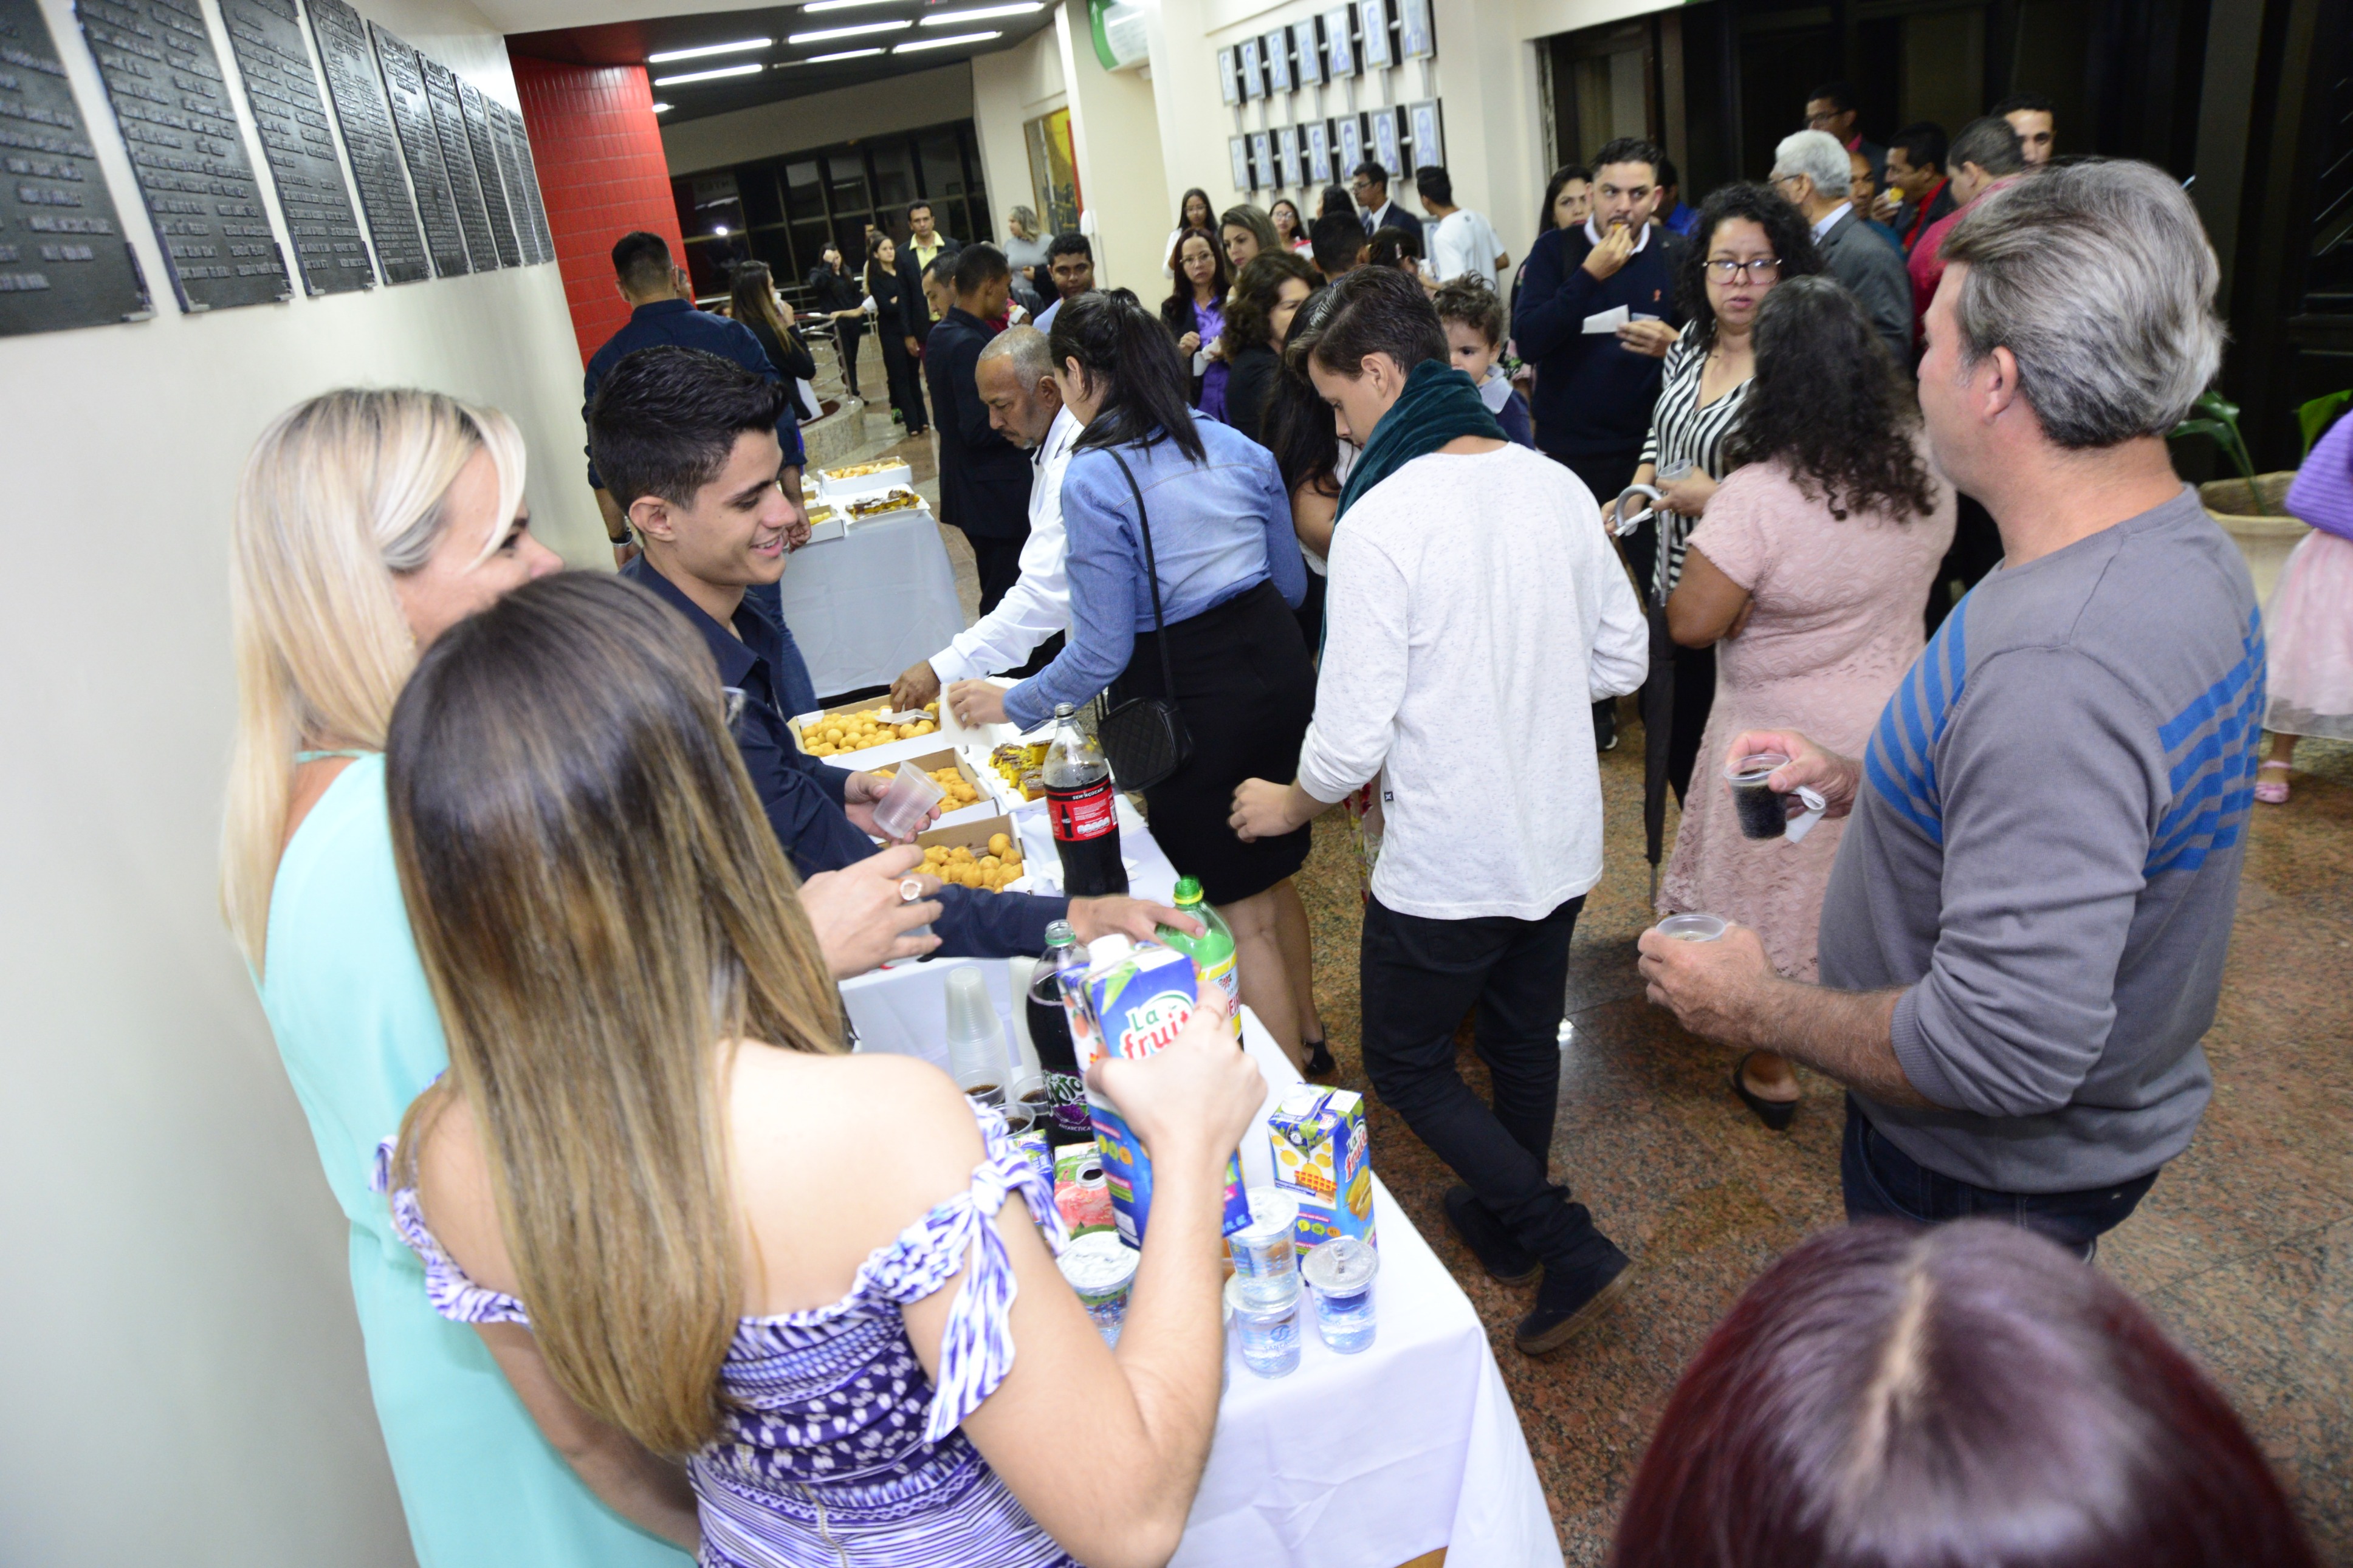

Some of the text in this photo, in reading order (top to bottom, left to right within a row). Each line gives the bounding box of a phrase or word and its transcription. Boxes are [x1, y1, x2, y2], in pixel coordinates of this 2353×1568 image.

[1131, 1009, 1160, 1032] La
[1059, 1123, 1091, 1131] ANTARCTICA
[1347, 1135, 1358, 1153] La
